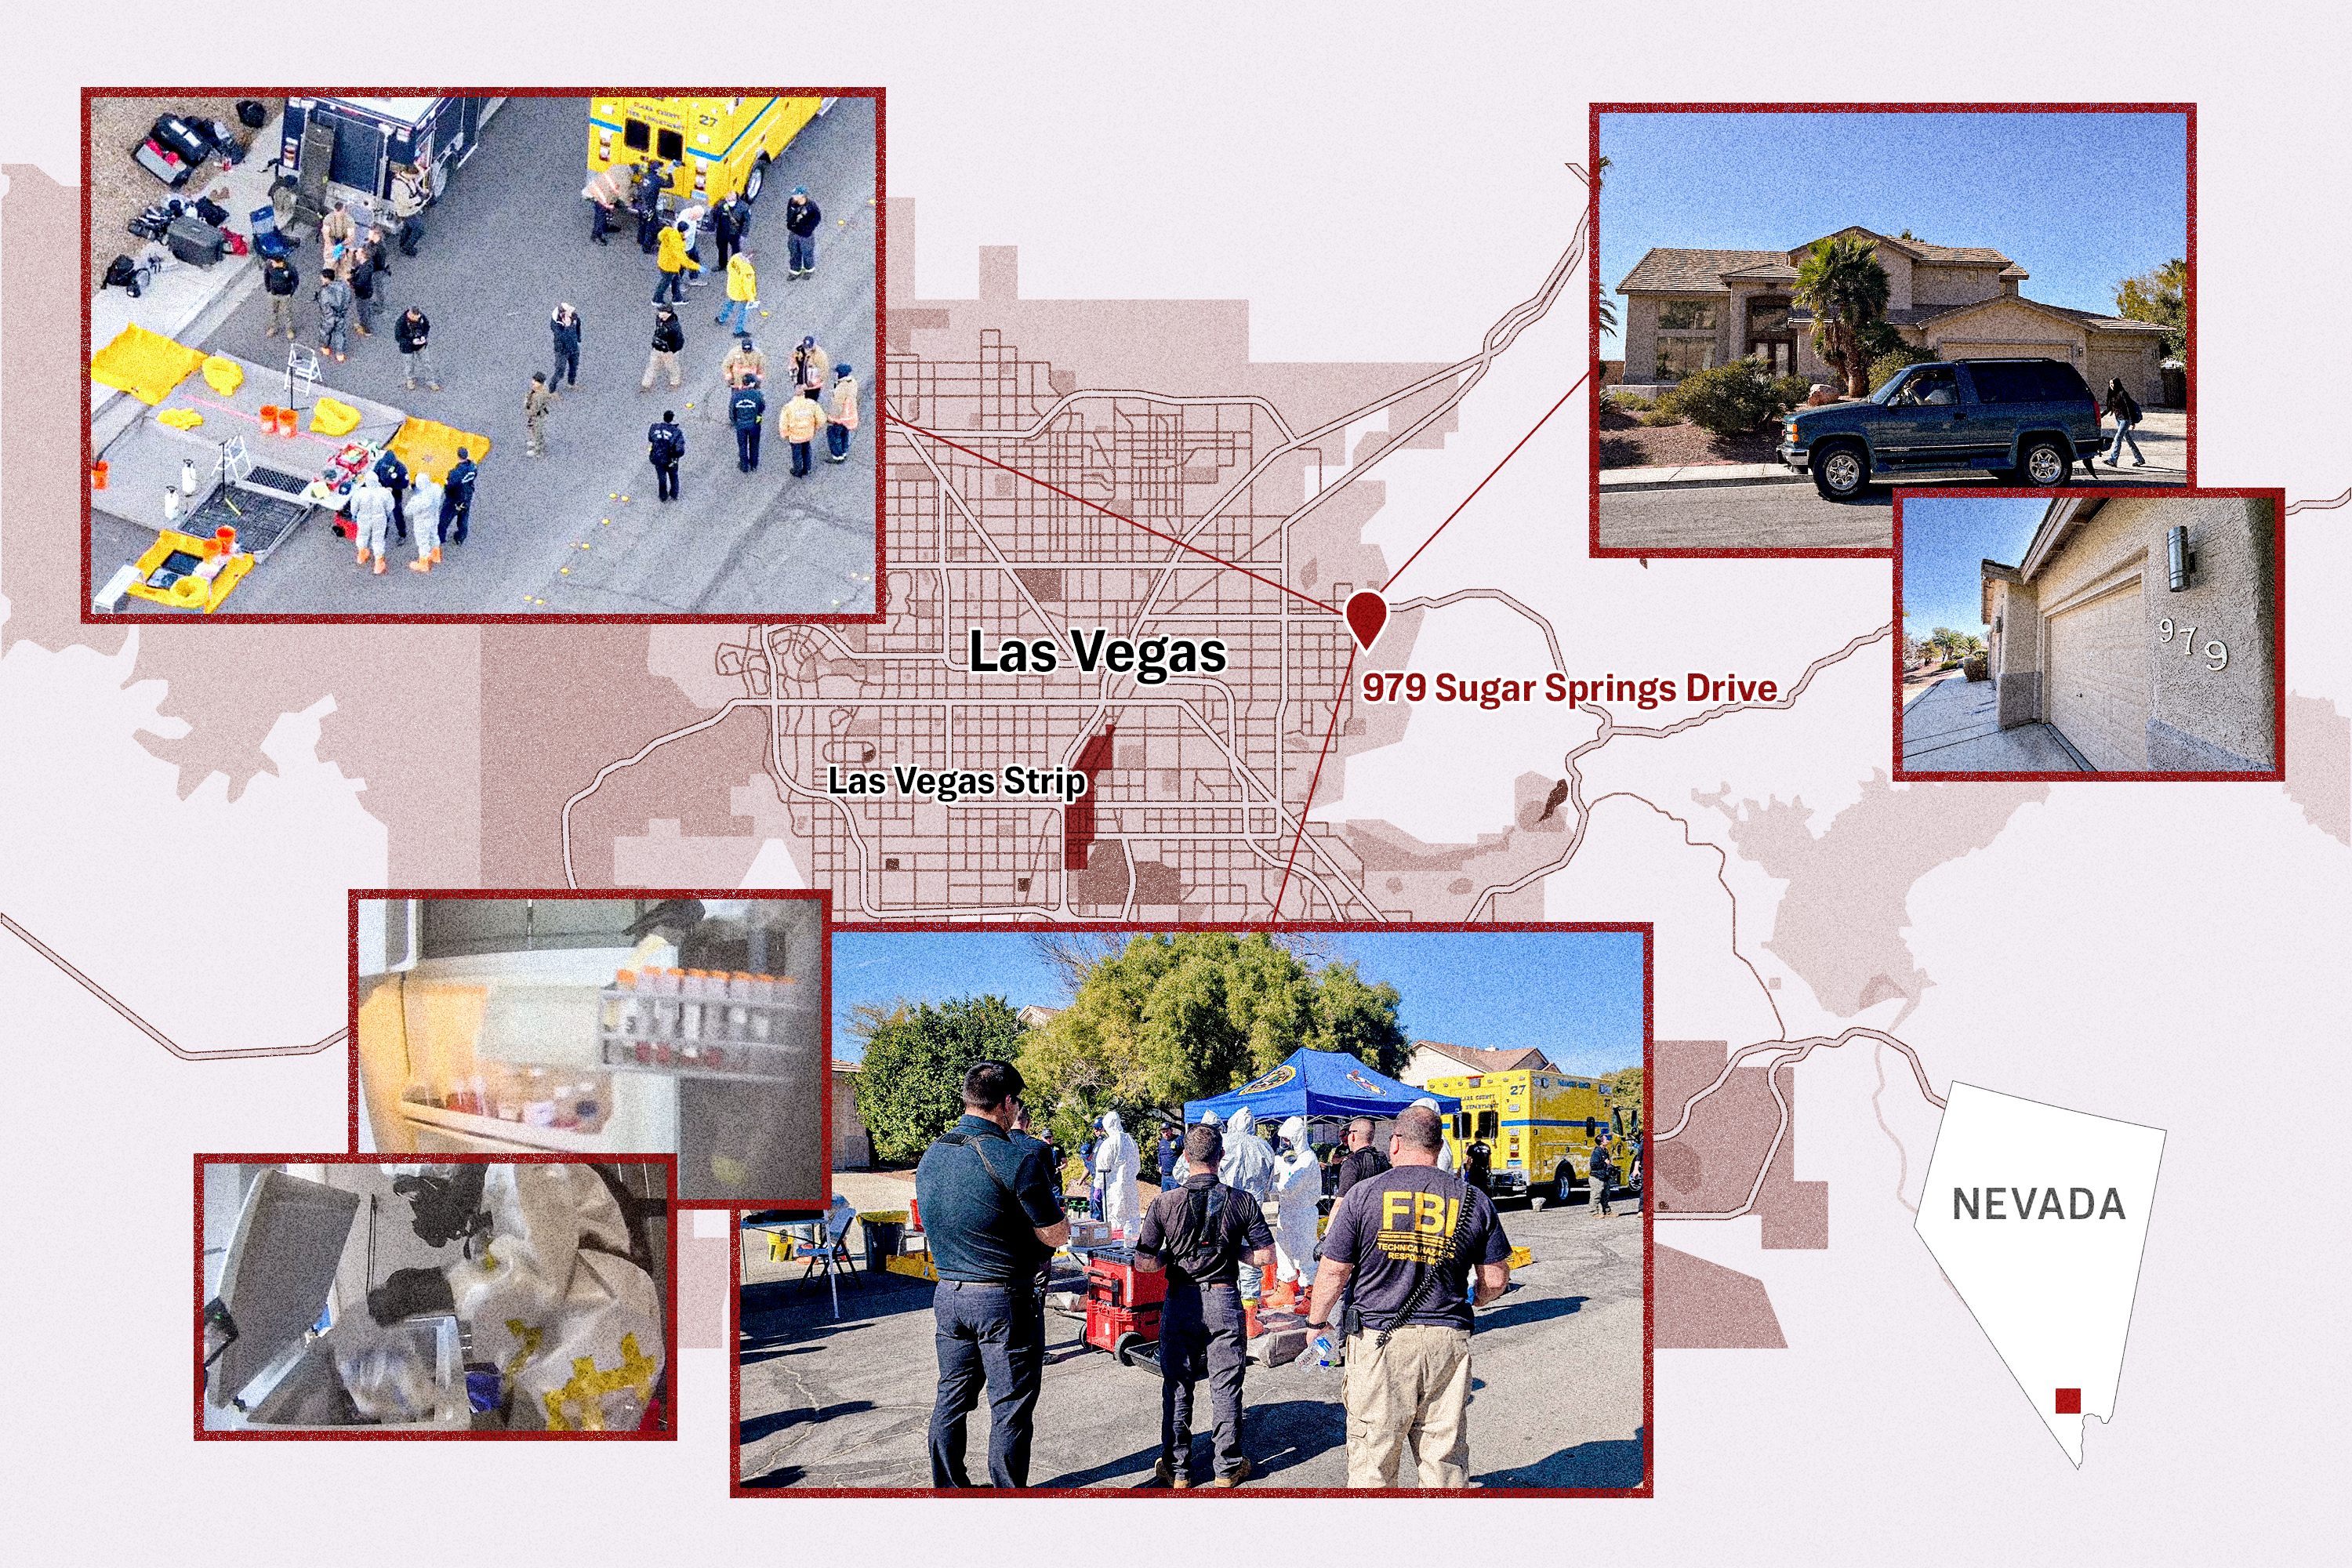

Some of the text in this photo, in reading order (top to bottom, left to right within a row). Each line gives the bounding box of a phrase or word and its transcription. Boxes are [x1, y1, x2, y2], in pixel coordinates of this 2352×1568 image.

[699, 114, 718, 127] 27
[2159, 618, 2229, 672] 979
[1510, 1084, 1526, 1095] 27
[1382, 1191, 1459, 1238] FBI
